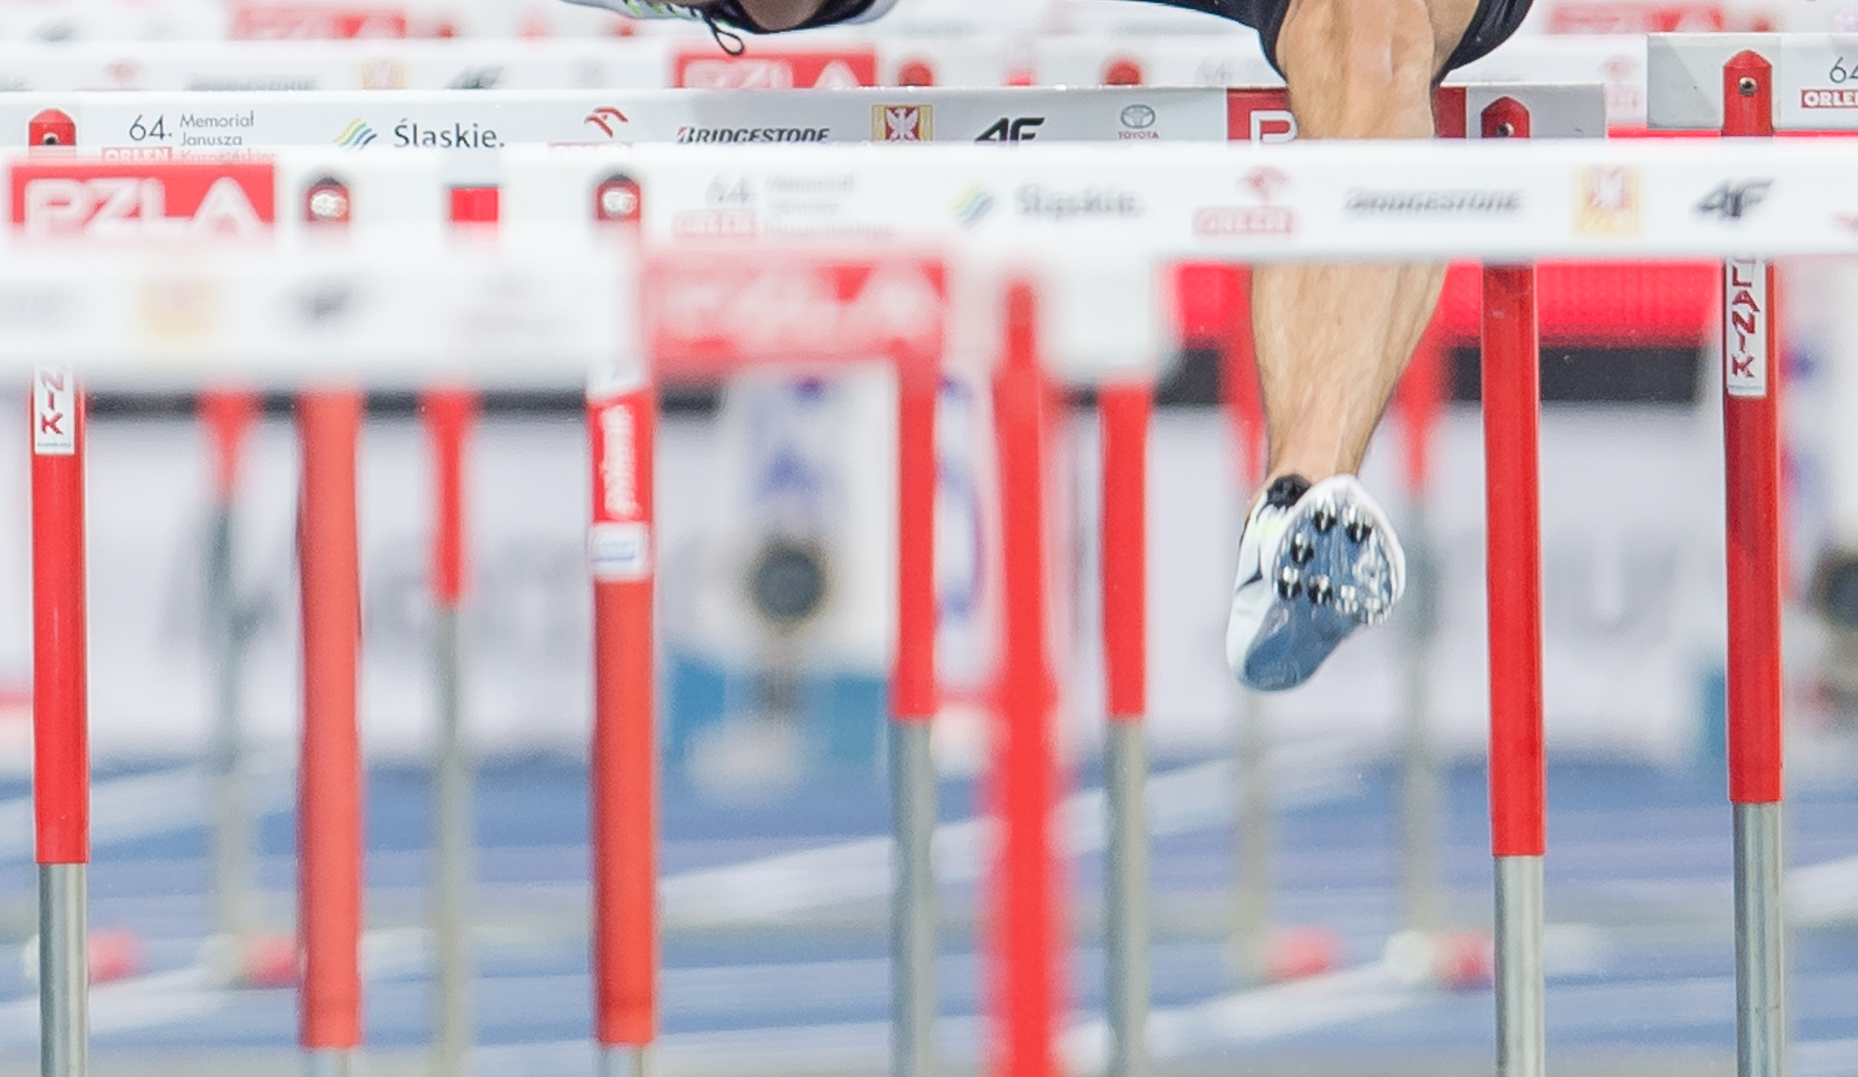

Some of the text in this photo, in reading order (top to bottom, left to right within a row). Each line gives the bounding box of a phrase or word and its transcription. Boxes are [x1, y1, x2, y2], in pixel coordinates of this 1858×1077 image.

[129, 114, 173, 141] 64.
[1117, 130, 1160, 140] TOYOTA
[1731, 259, 1761, 378] LANIK
